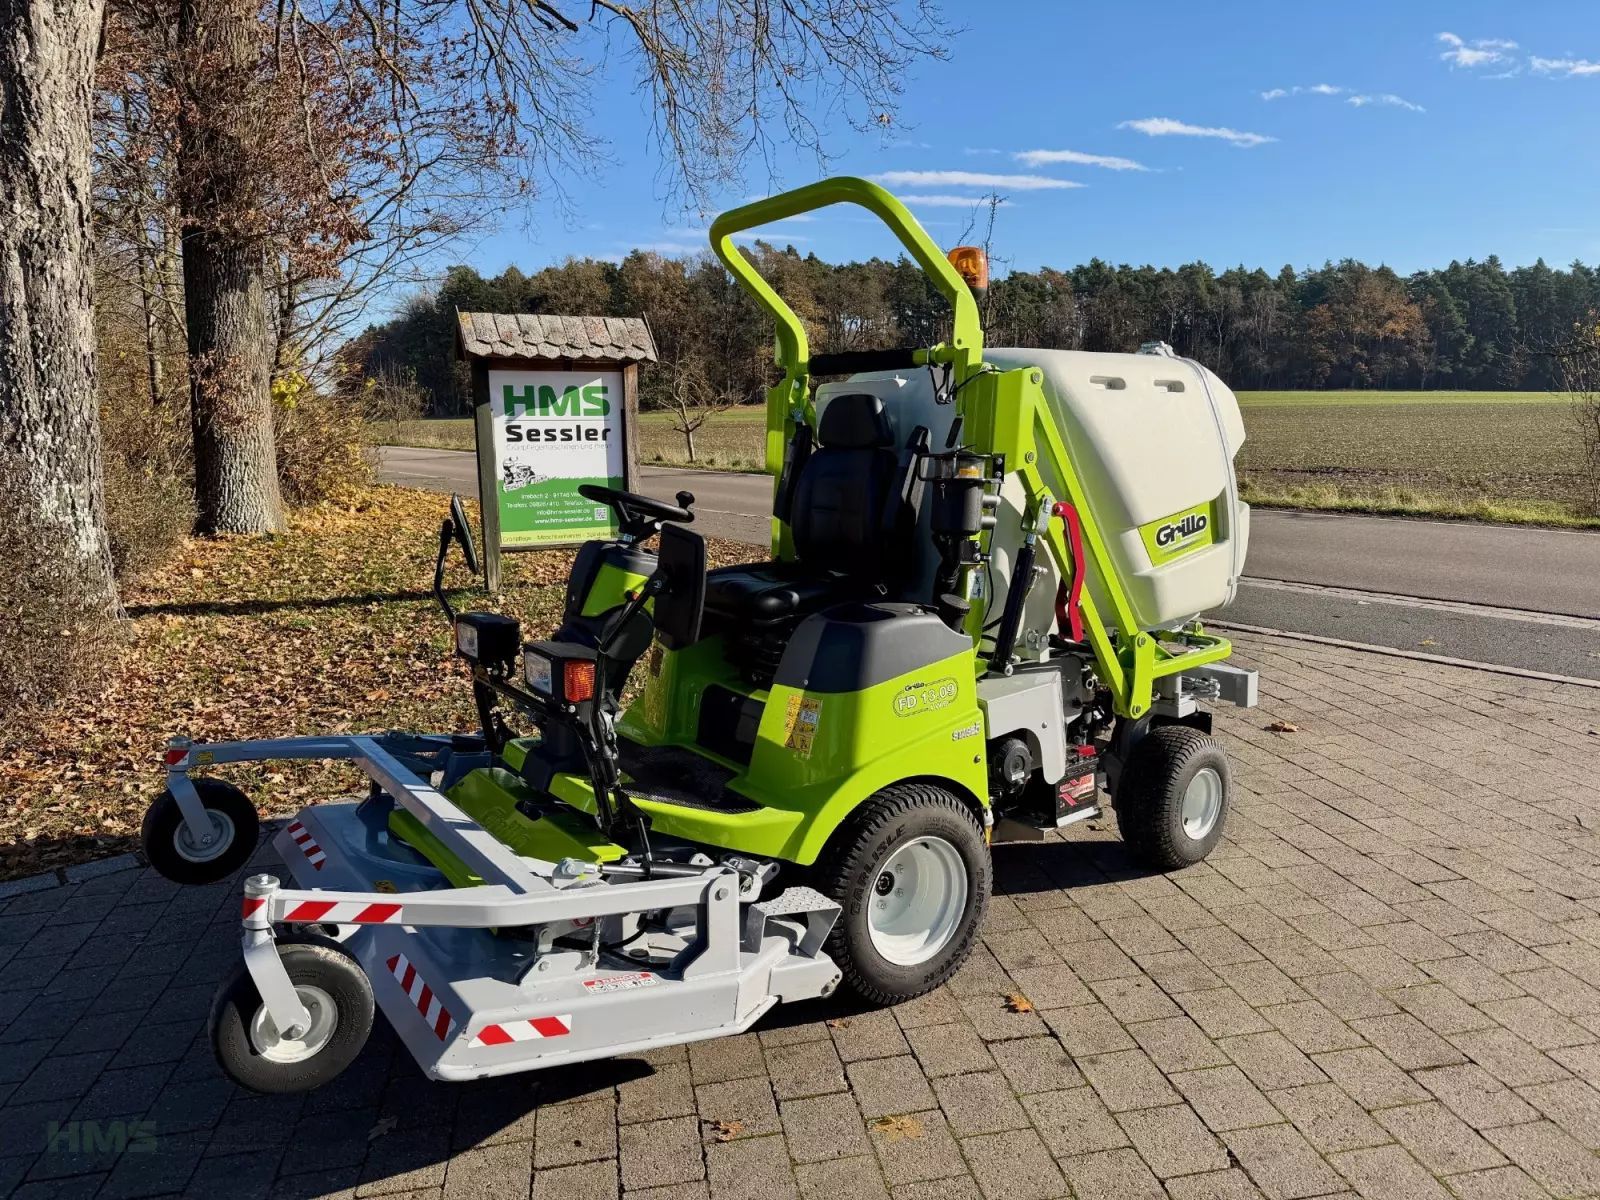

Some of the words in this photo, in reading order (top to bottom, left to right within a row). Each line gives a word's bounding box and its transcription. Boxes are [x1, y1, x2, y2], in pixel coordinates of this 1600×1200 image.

[503, 385, 610, 416] HMS
[505, 424, 611, 442] Sessler
[1155, 514, 1207, 547] Grillo
[898, 695, 917, 711] FD
[922, 684, 955, 704] 13.09
[850, 824, 906, 916] CARLISLE
